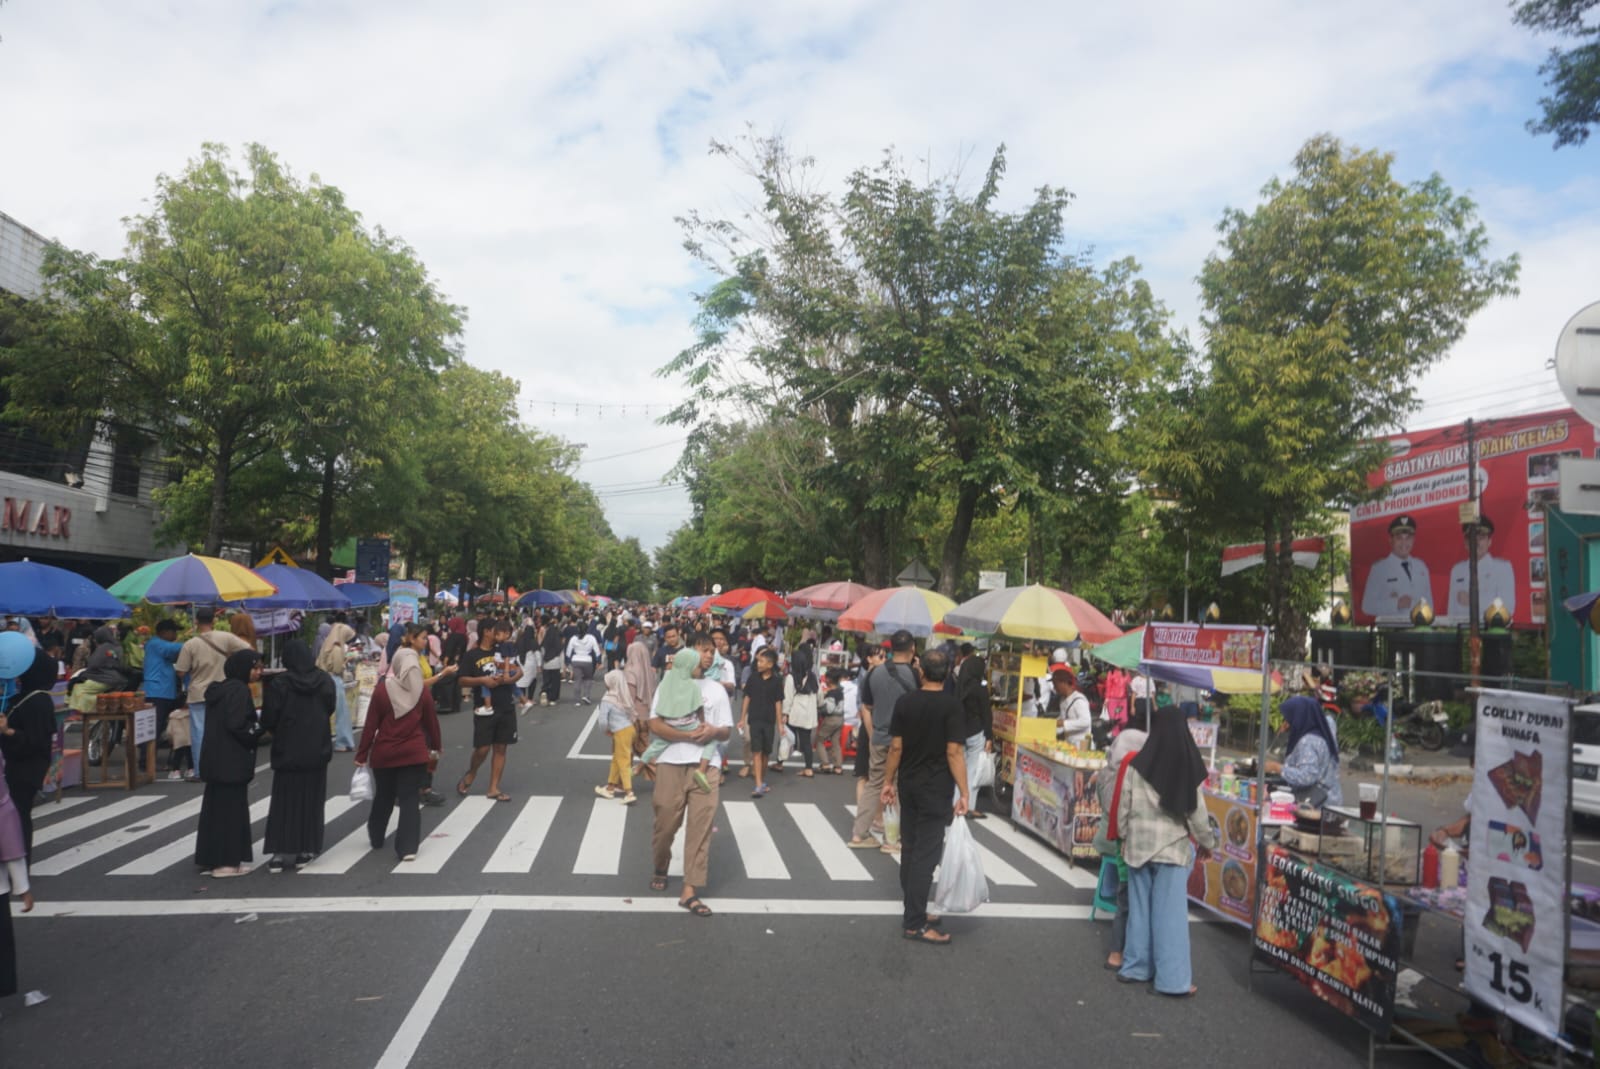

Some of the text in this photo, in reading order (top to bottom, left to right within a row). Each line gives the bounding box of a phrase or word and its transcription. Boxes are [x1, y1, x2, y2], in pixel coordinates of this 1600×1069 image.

[1386, 453, 1440, 480] SAATNYA
[1479, 434, 1513, 456] NAIK
[1517, 423, 1567, 447] KELAS
[1412, 478, 1430, 491] dari
[1431, 472, 1467, 490] gerakan
[1356, 483, 1470, 517] CINTA PRODUK INDONES
[2, 496, 72, 538] MAR
[1482, 705, 1565, 729] COKLAT DUBAI
[1501, 725, 1541, 744] KUNAFA
[1301, 866, 1332, 892] PUTU
[1300, 886, 1328, 910] SEDIA
[1355, 942, 1396, 971] TEMPURA
[1488, 951, 1534, 1004] 15
[1352, 990, 1384, 1018] KLATEN
